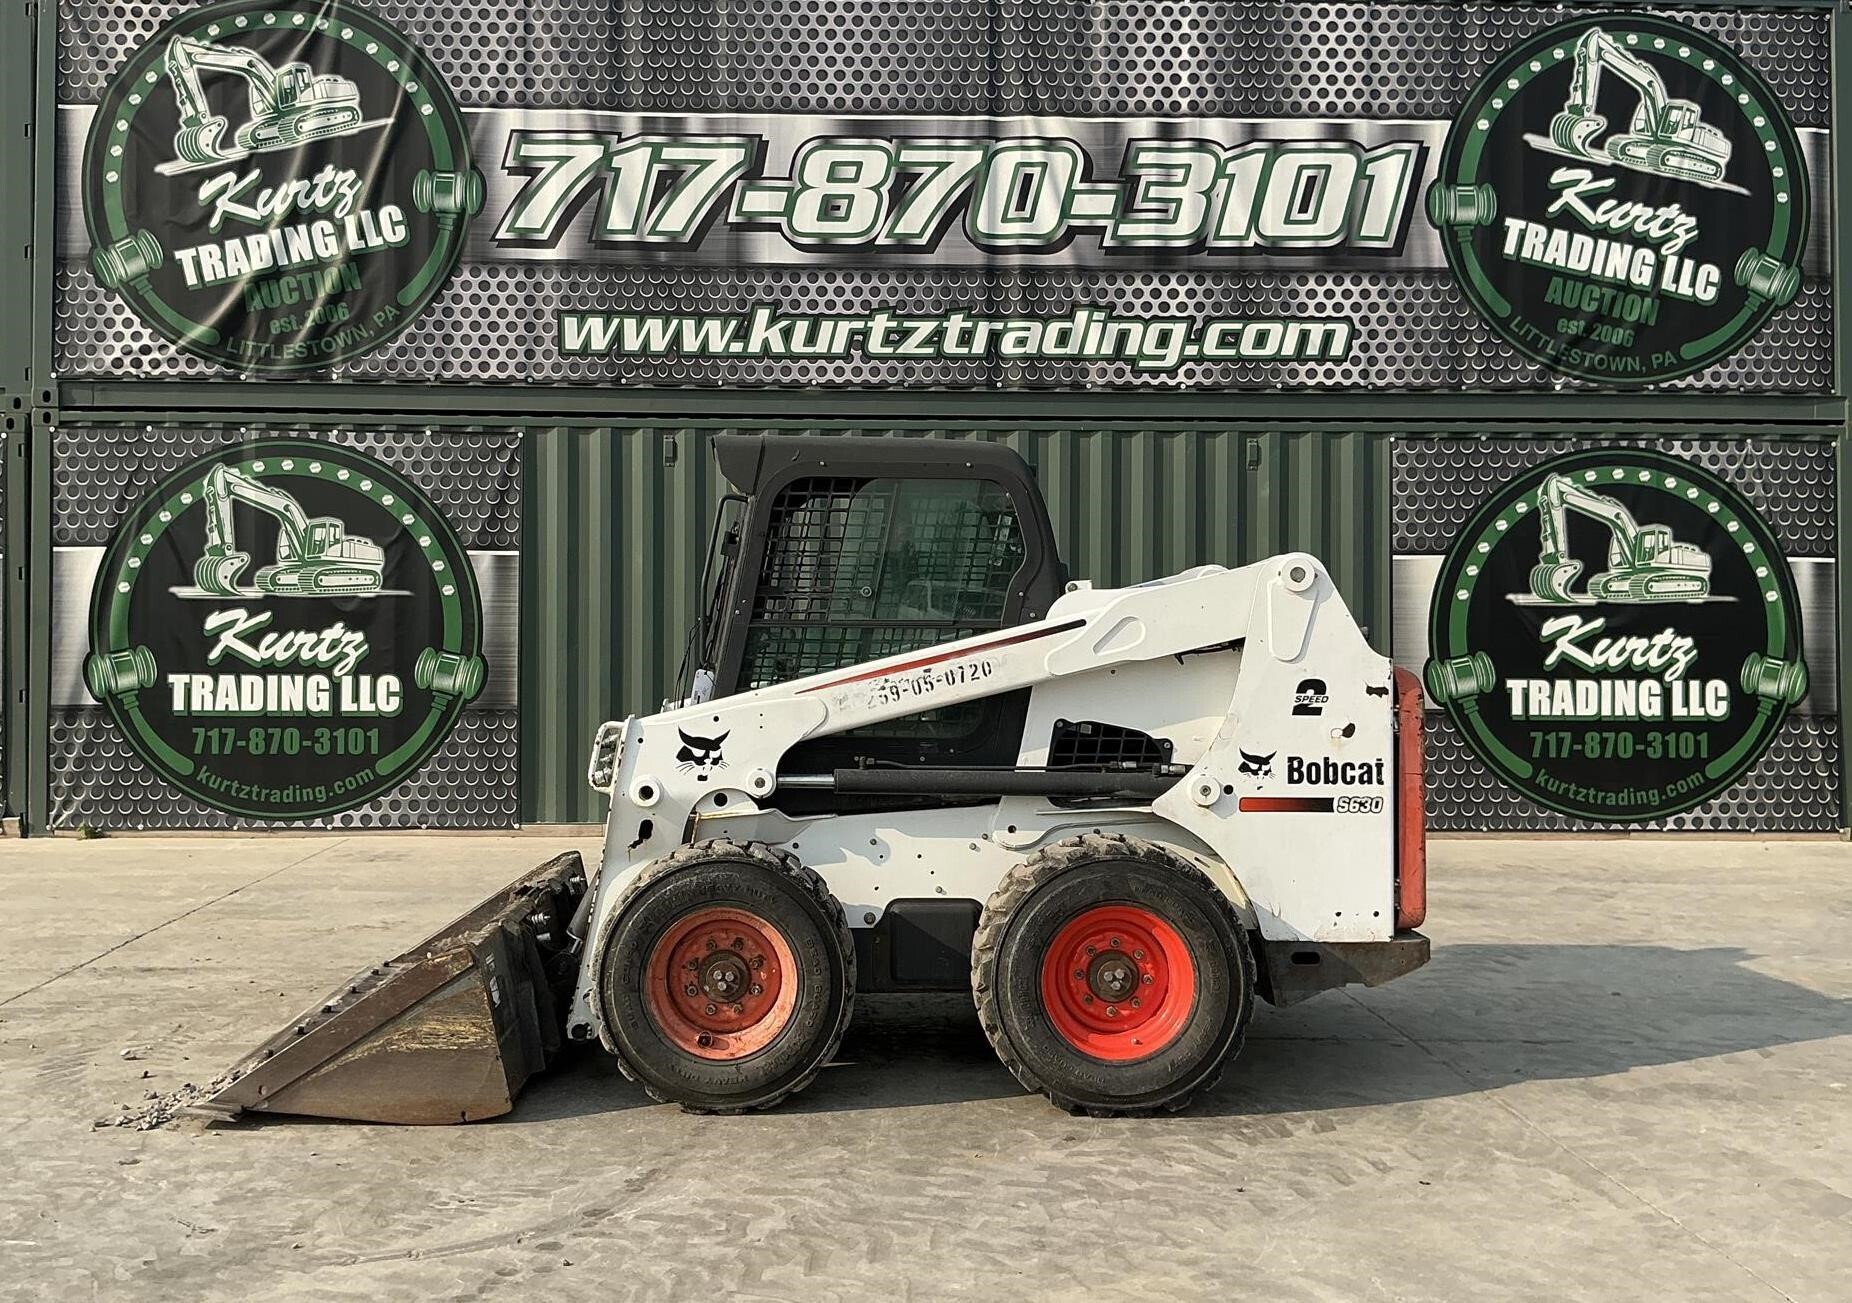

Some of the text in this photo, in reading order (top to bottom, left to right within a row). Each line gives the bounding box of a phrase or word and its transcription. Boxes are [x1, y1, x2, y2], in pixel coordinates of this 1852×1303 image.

[199, 163, 362, 231] Kurtz
[499, 133, 1422, 248] 717-870-3101
[1546, 167, 1699, 255] Kurtz
[174, 203, 410, 289] TRADING LLC
[1503, 217, 1721, 305] TRADING LLC
[243, 262, 363, 313] AUCTION
[1545, 276, 1661, 326] AUCTION
[226, 303, 401, 359] LITTLESTOWN, PA
[269, 302, 350, 336] est. 2006
[561, 306, 1352, 371] www.kurtztrading.com
[1556, 316, 1635, 349] est. 2006
[1509, 315, 1678, 374] LITTLESTOWN, PA
[204, 608, 369, 677] Kurtz
[1540, 614, 1697, 682] Kurtz
[168, 674, 402, 716] TRADING LLC
[1292, 678, 1327, 716] 2
[1294, 694, 1329, 704] SPEED
[1506, 679, 1731, 721] TRADING LLC
[192, 728, 379, 756] 717-870-3101
[1531, 732, 1709, 759] 717-870-3101
[196, 766, 376, 804] kurtztrading.com
[1287, 756, 1385, 785] Bobcat
[1535, 770, 1706, 807] kurtztrading.com
[1336, 796, 1384, 814] S630
